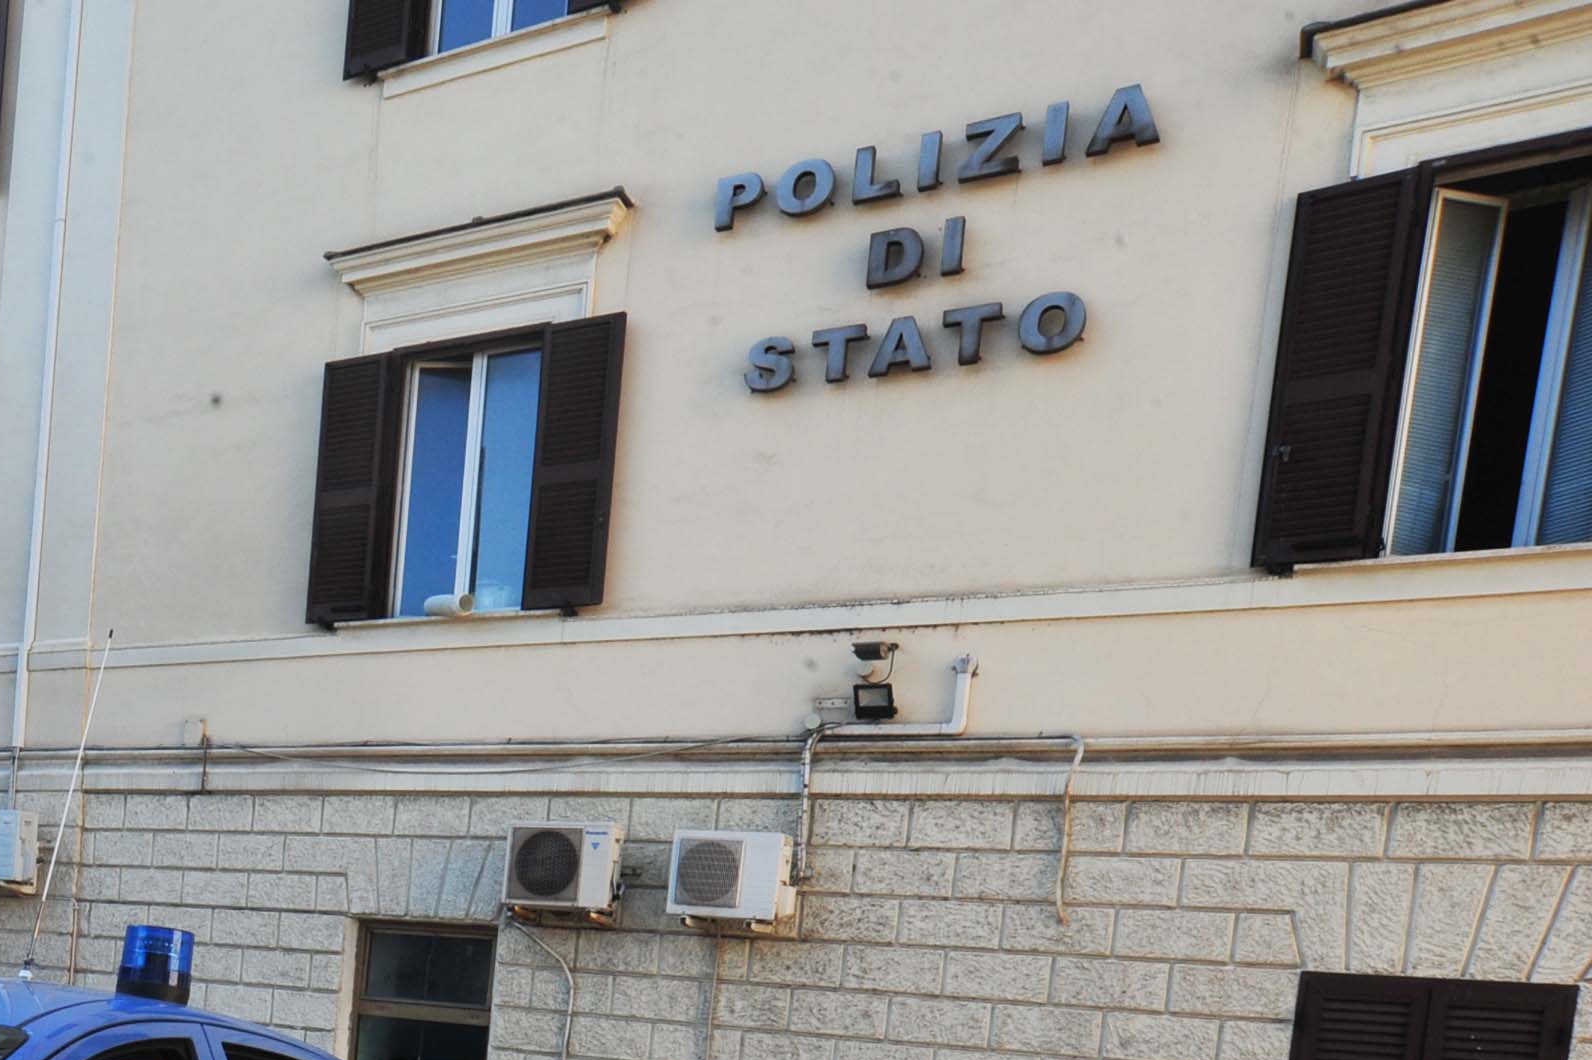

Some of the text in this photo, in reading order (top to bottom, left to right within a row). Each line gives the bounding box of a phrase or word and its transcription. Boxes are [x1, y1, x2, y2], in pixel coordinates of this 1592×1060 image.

[715, 83, 1160, 231] POLIZIA
[866, 216, 966, 290] DI
[744, 291, 1087, 393] STATO
